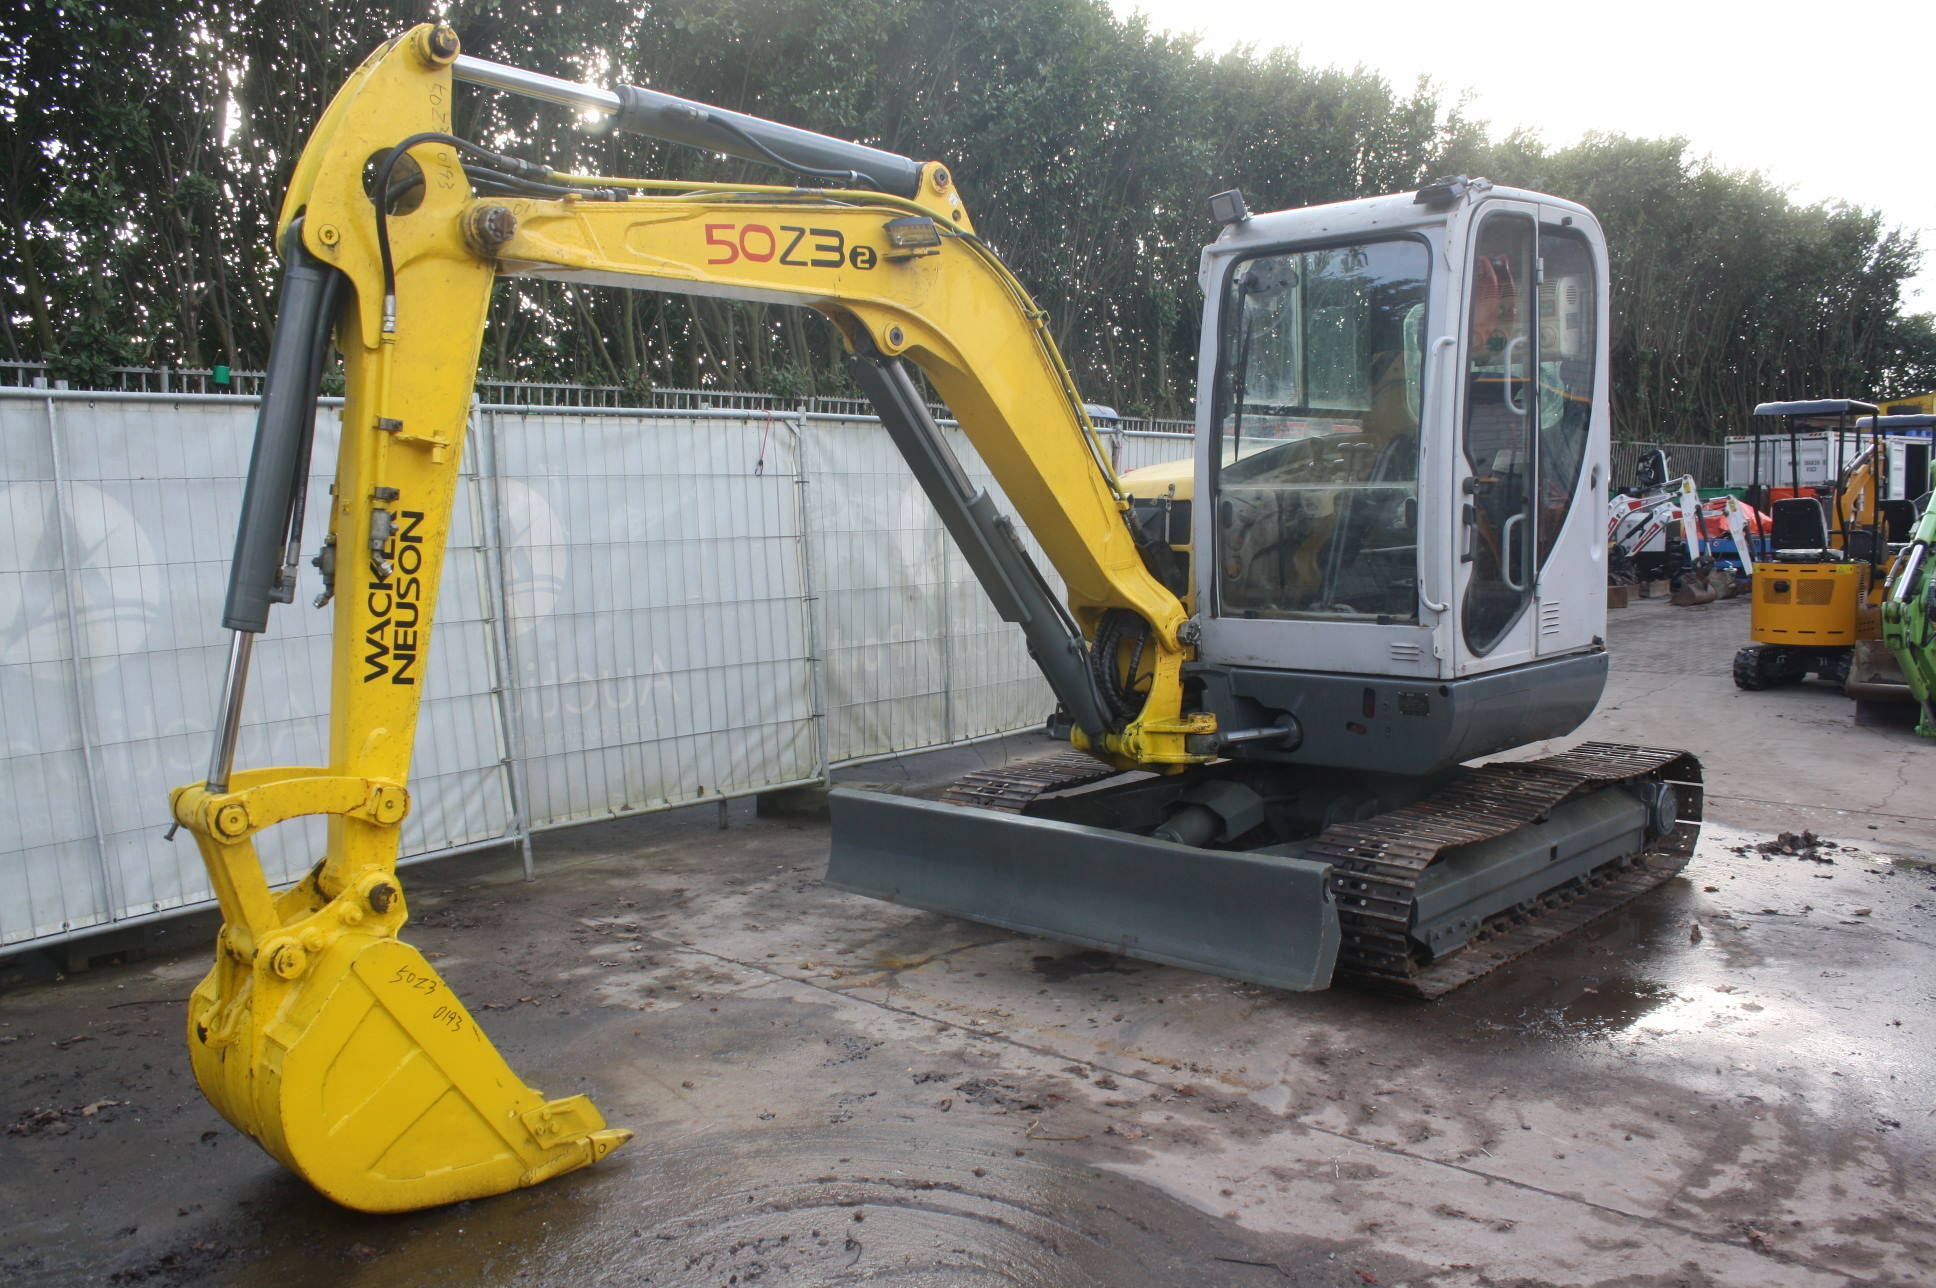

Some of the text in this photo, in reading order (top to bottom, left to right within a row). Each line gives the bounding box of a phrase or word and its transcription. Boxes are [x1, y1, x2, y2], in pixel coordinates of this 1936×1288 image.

[704, 223, 846, 269] 50Z3
[363, 510, 398, 684] WACKE
[391, 510, 425, 686] NEUSON
